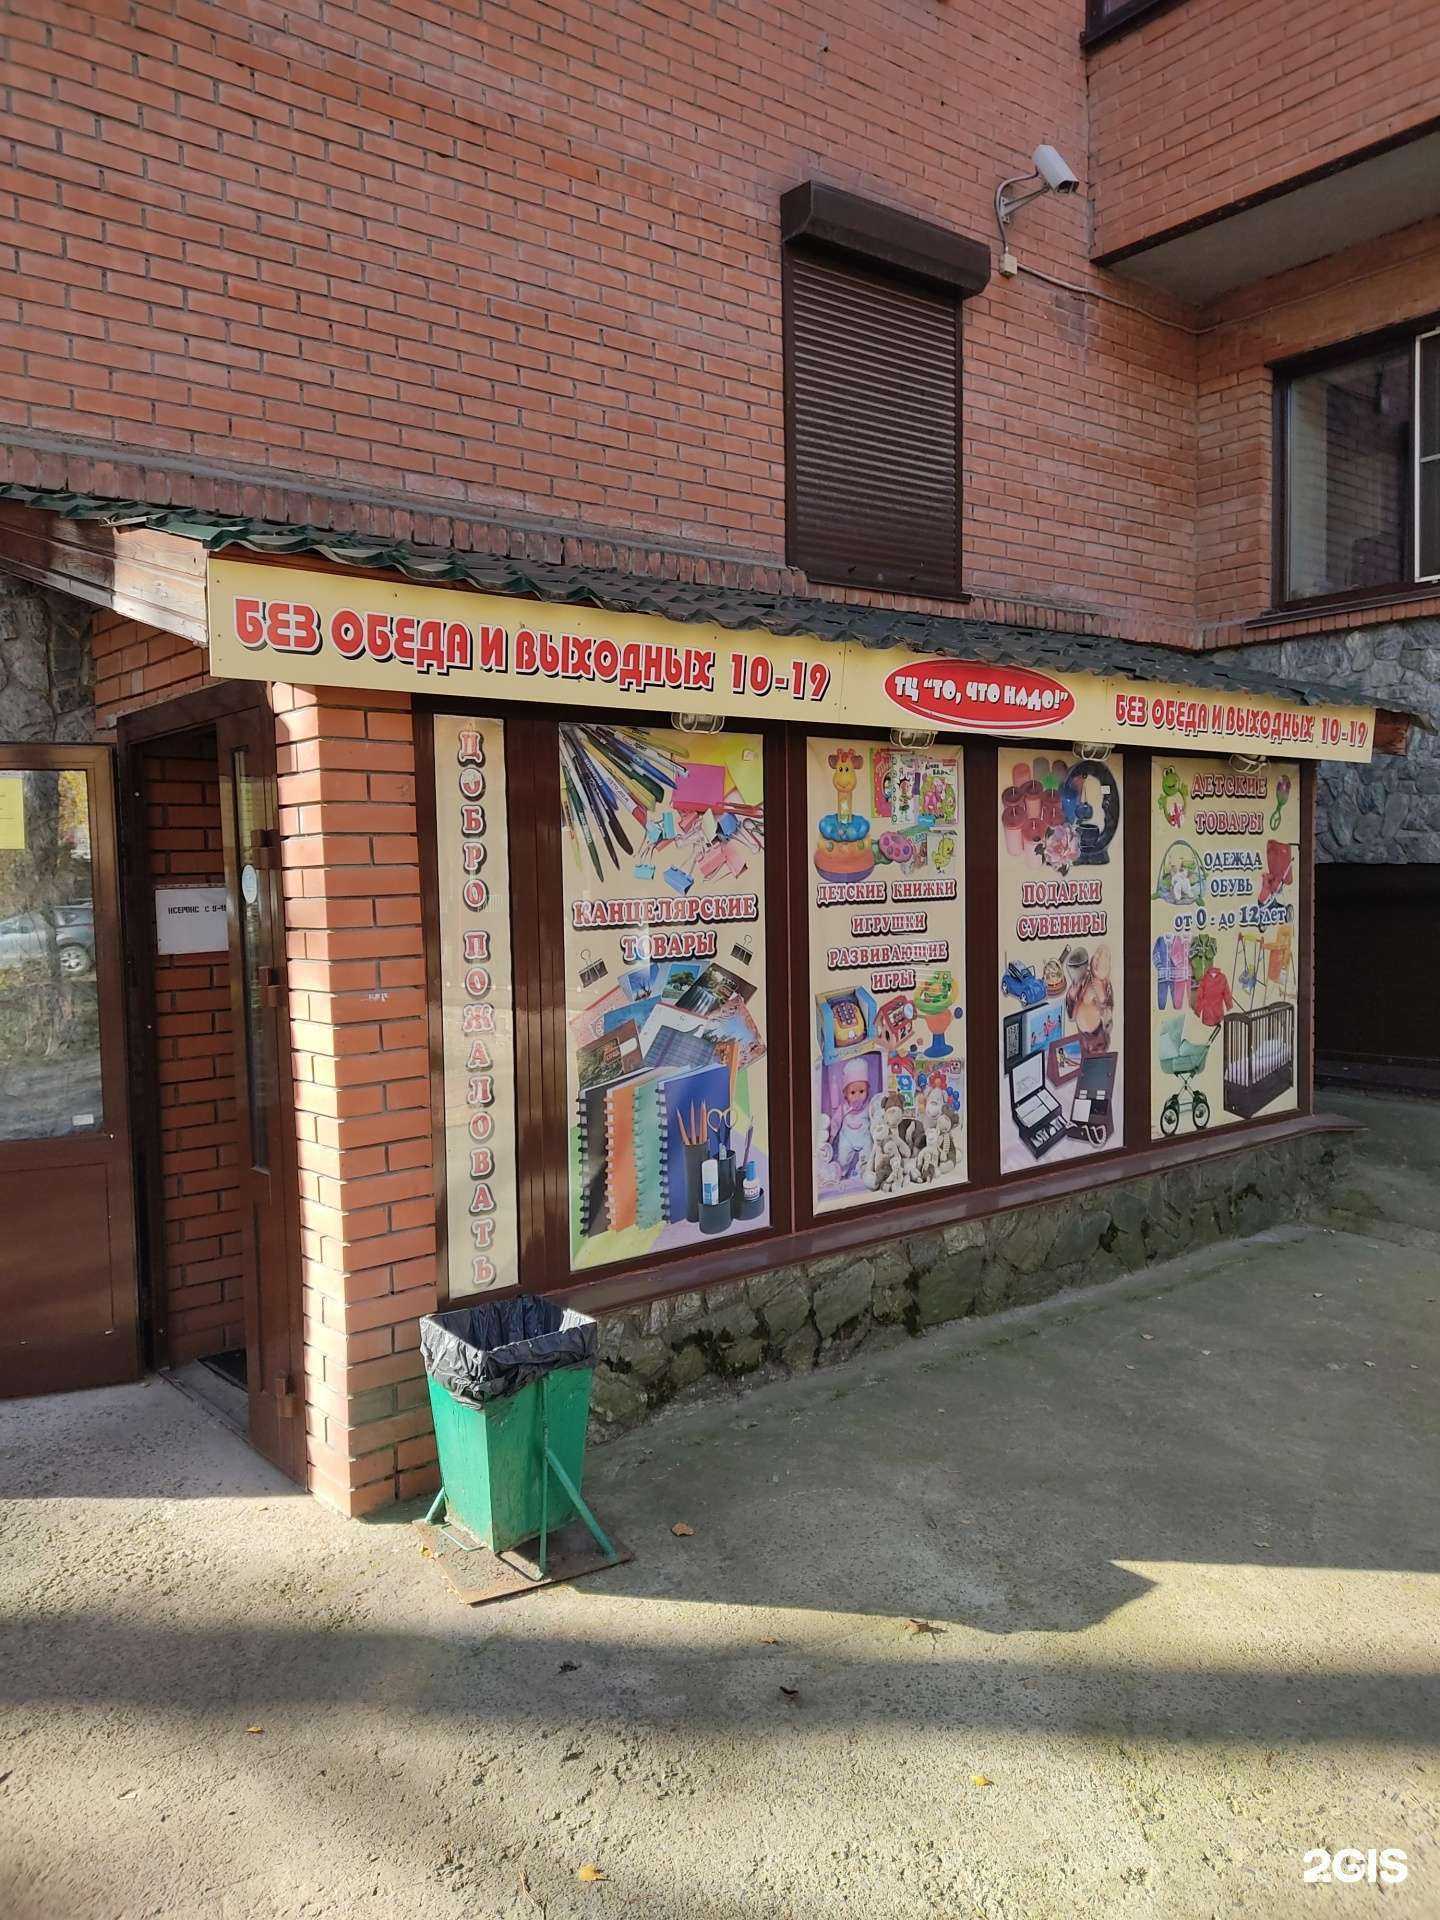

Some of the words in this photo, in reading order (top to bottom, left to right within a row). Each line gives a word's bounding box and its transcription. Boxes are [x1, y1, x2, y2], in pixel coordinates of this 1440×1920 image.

[233, 597, 322, 655] БЕЗ
[330, 607, 473, 675] ОБЕДА
[479, 625, 508, 673] И
[514, 630, 716, 692] ВЫХОДНЫХ
[730, 651, 833, 701] 10-19
[894, 675, 919, 703] ТЦ
[965, 681, 1001, 703] ЧТО
[1114, 694, 1149, 726] БЕЗ
[1151, 698, 1209, 737] ОБЕДА
[1211, 704, 1225, 734] И
[1225, 706, 1317, 744] ВЫХОДНЫХ
[1320, 717, 1370, 748] 10-19
[1191, 775, 1268, 800] ДЕТСКИЕ
[457, 728, 488, 911] ДОБРО
[1194, 811, 1264, 836] ТОВАРЫ
[1203, 852, 1263, 873] ОДЕЖДА
[816, 881, 887, 907] ДЕТСКИЕ
[891, 879, 957, 903] КНИЖКИ
[1022, 880, 1103, 907] ПОДАРКИ
[1210, 878, 1254, 897] ОБУВЬ
[572, 895, 758, 930] КАНЦЕЛЯРСКИЕ
[851, 912, 928, 935] ИГРУШКИ
[1017, 911, 1107, 940] СУВЕНИРЫ
[1174, 914, 1192, 932] от
[1195, 907, 1208, 930] 0
[1218, 911, 1236, 930] до
[1239, 904, 1260, 927] 12
[1261, 906, 1286, 926] лет
[620, 931, 718, 963] ТОВАРЫ
[827, 940, 949, 970] РАЗВИВАЮЩИЕ
[871, 970, 916, 993] ИГРЫ
[462, 930, 497, 1289] ПОЖАЛОВАТЬ
